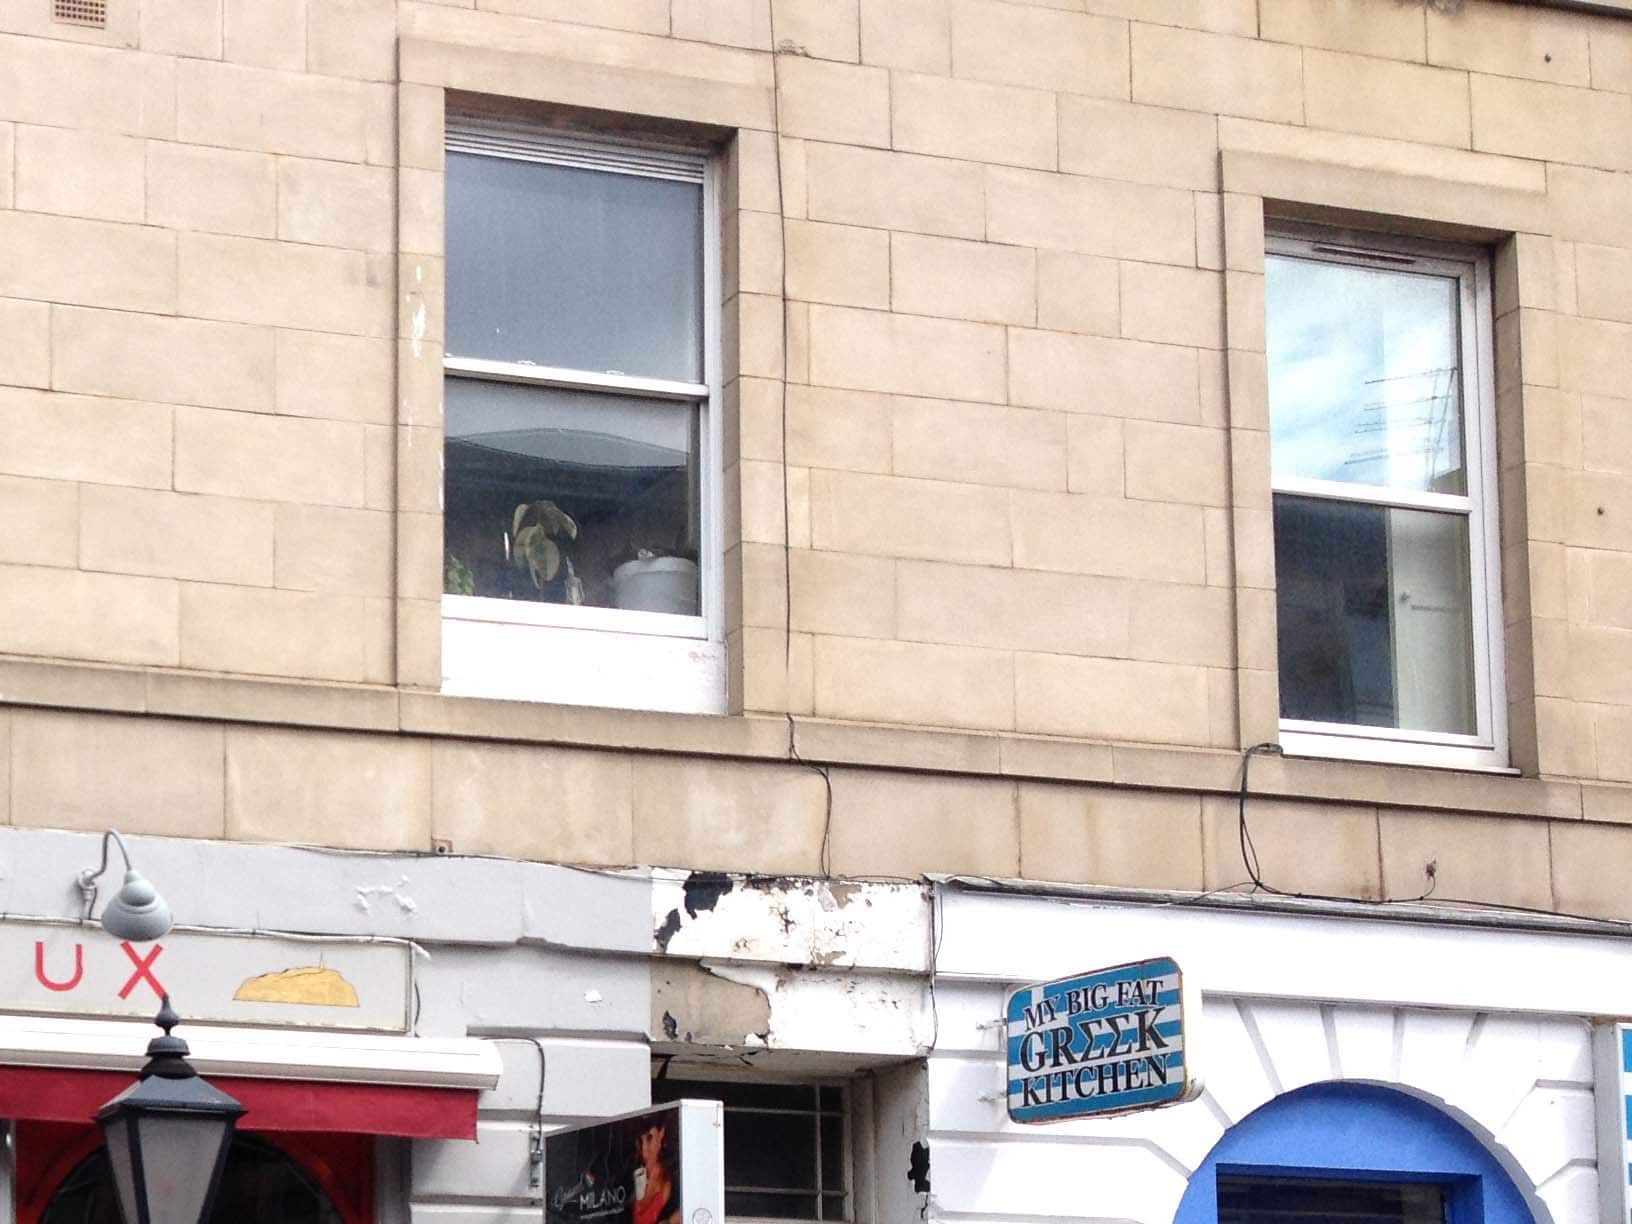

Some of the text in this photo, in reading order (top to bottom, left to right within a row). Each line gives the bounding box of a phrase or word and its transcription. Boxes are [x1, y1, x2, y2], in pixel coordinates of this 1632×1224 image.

[1024, 980, 1164, 1031] MY BIG FAT
[1021, 1054, 1171, 1107] KITCHEN
[579, 1185, 626, 1211] MILANO
